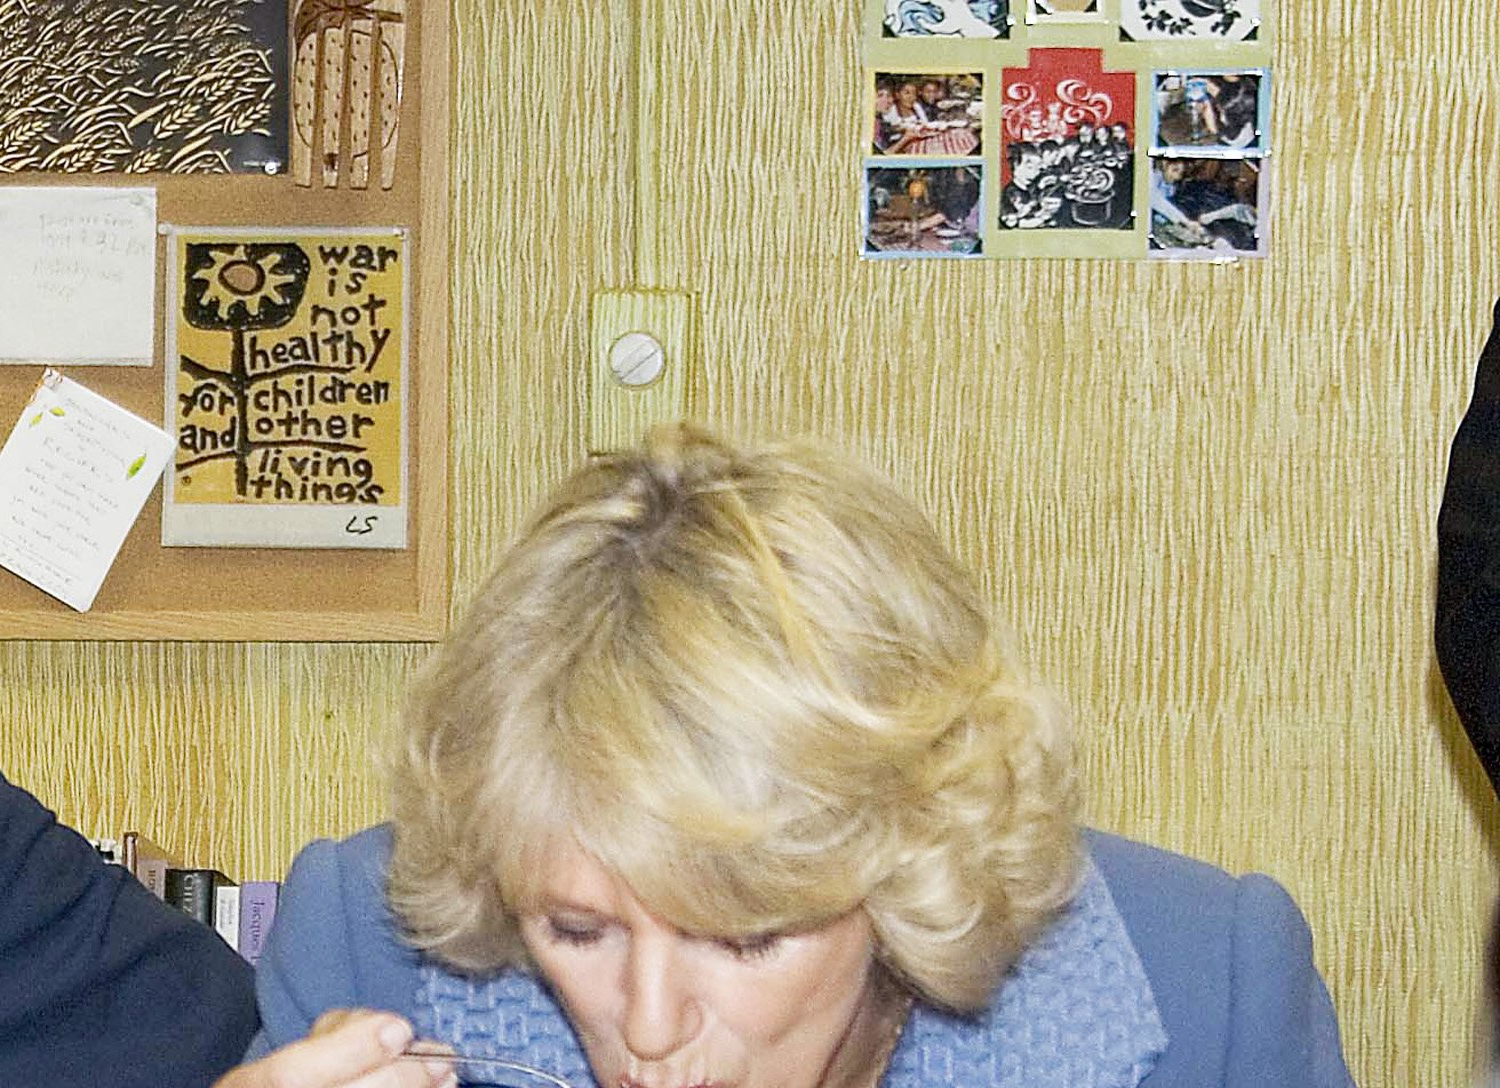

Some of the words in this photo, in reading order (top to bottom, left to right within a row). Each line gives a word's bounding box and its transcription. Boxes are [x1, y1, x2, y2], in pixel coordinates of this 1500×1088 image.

[318, 244, 398, 271] war
[327, 268, 368, 297] is
[311, 294, 386, 326] not
[248, 328, 391, 373] healthy
[179, 383, 236, 416] for
[253, 375, 389, 412] children
[179, 417, 237, 453] and
[255, 410, 375, 439] other
[259, 450, 373, 486] living
[249, 472, 385, 504] things
